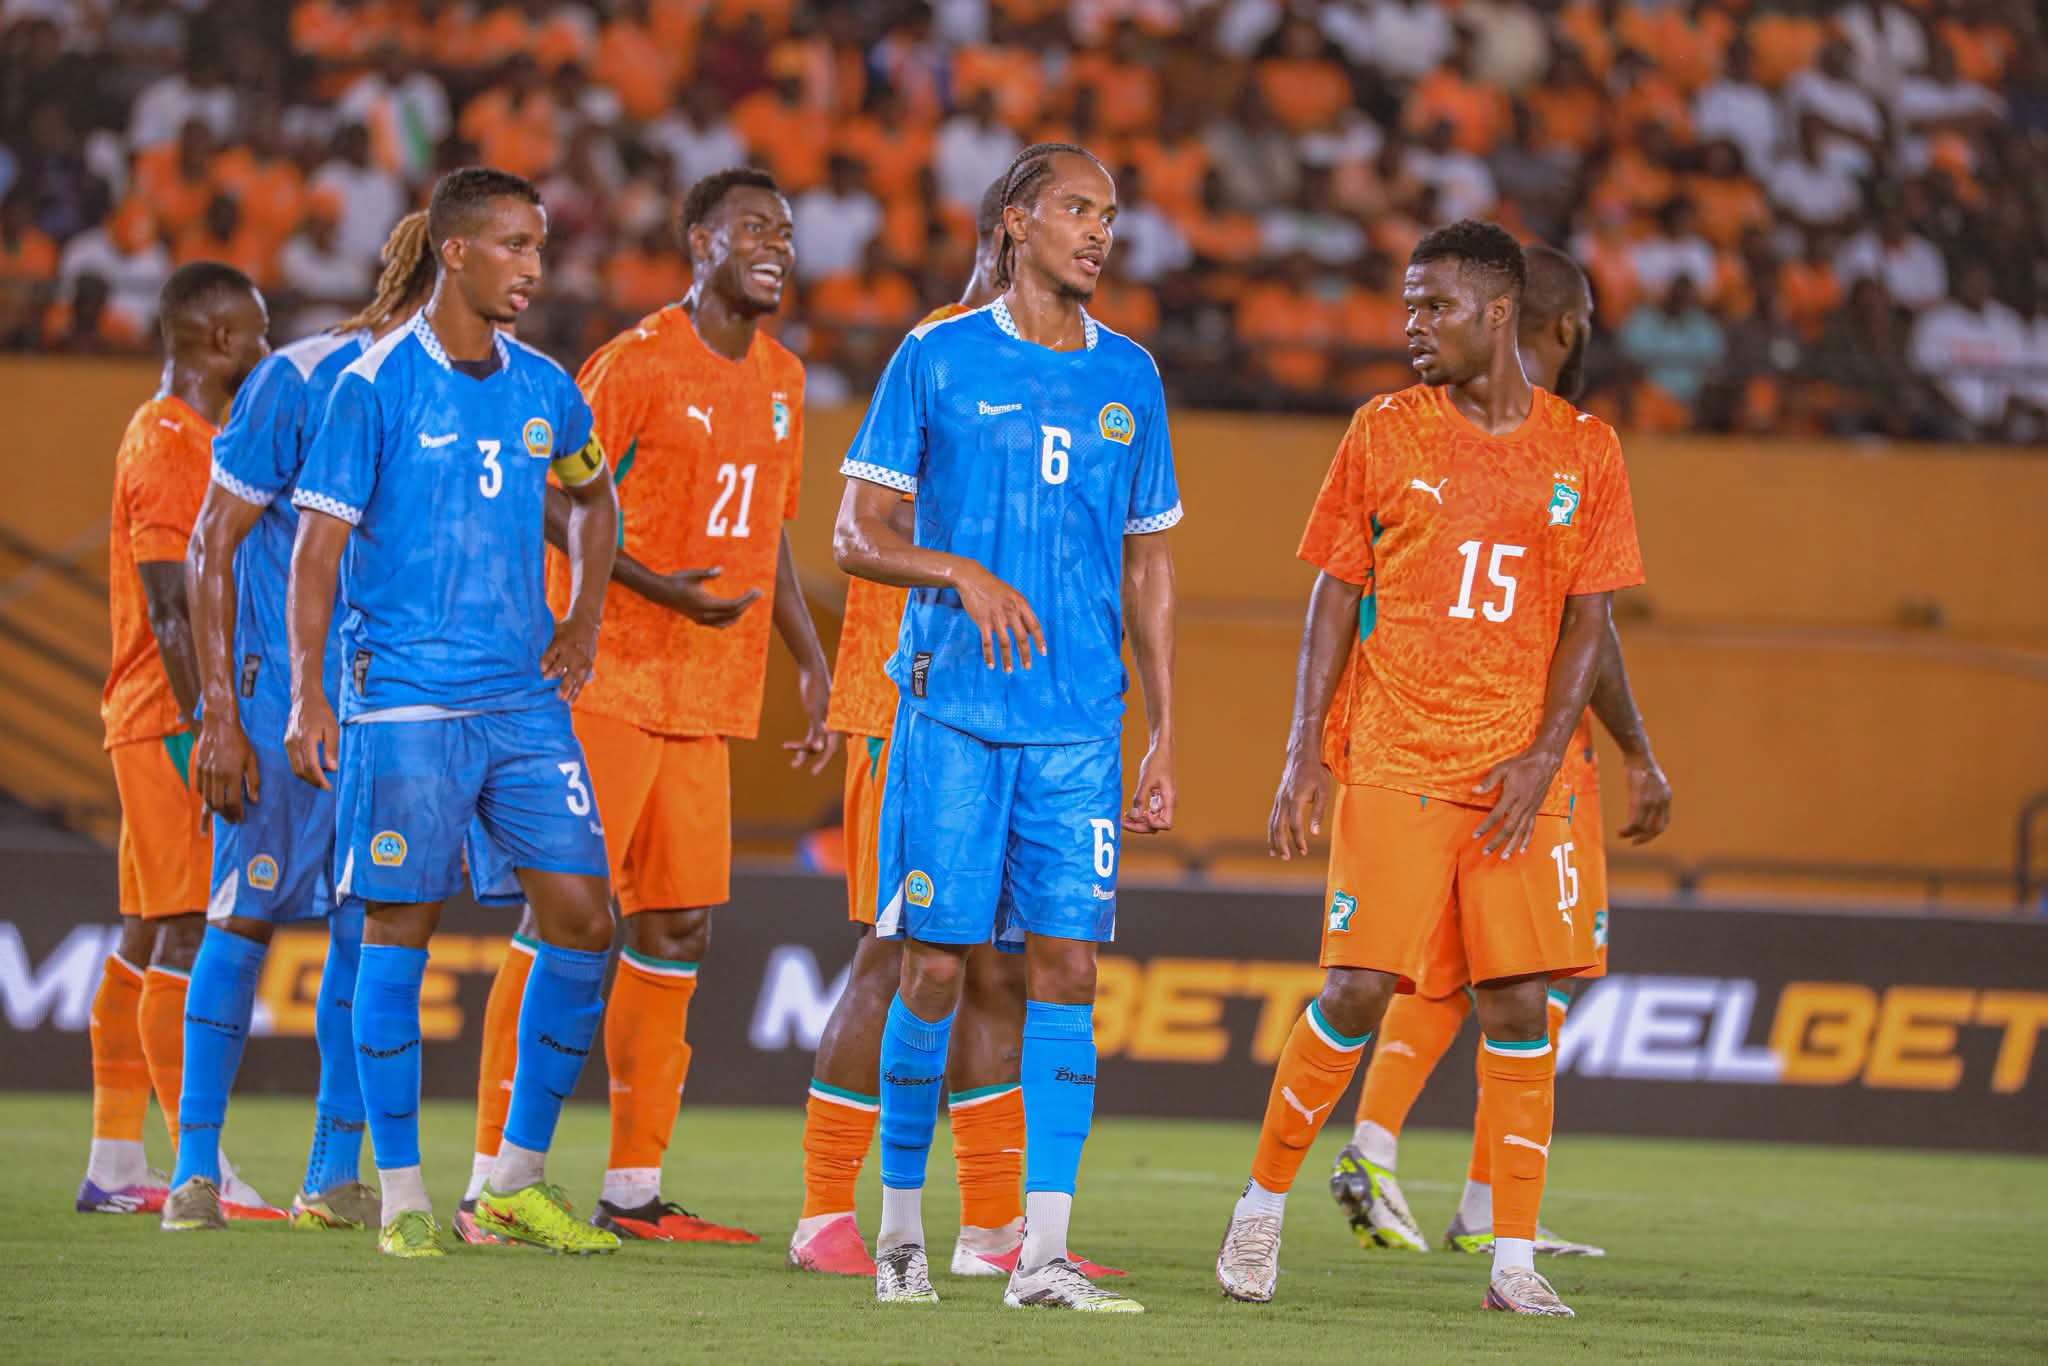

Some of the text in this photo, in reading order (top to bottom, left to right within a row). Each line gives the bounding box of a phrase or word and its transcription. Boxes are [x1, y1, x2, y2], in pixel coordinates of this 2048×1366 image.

[476, 440, 503, 499] 3
[1041, 425, 1072, 485] 6
[706, 463, 757, 538] 21
[1448, 540, 1528, 622] 15
[557, 761, 590, 816] 3
[1089, 818, 1115, 878] 6
[1550, 842, 1578, 911] 15
